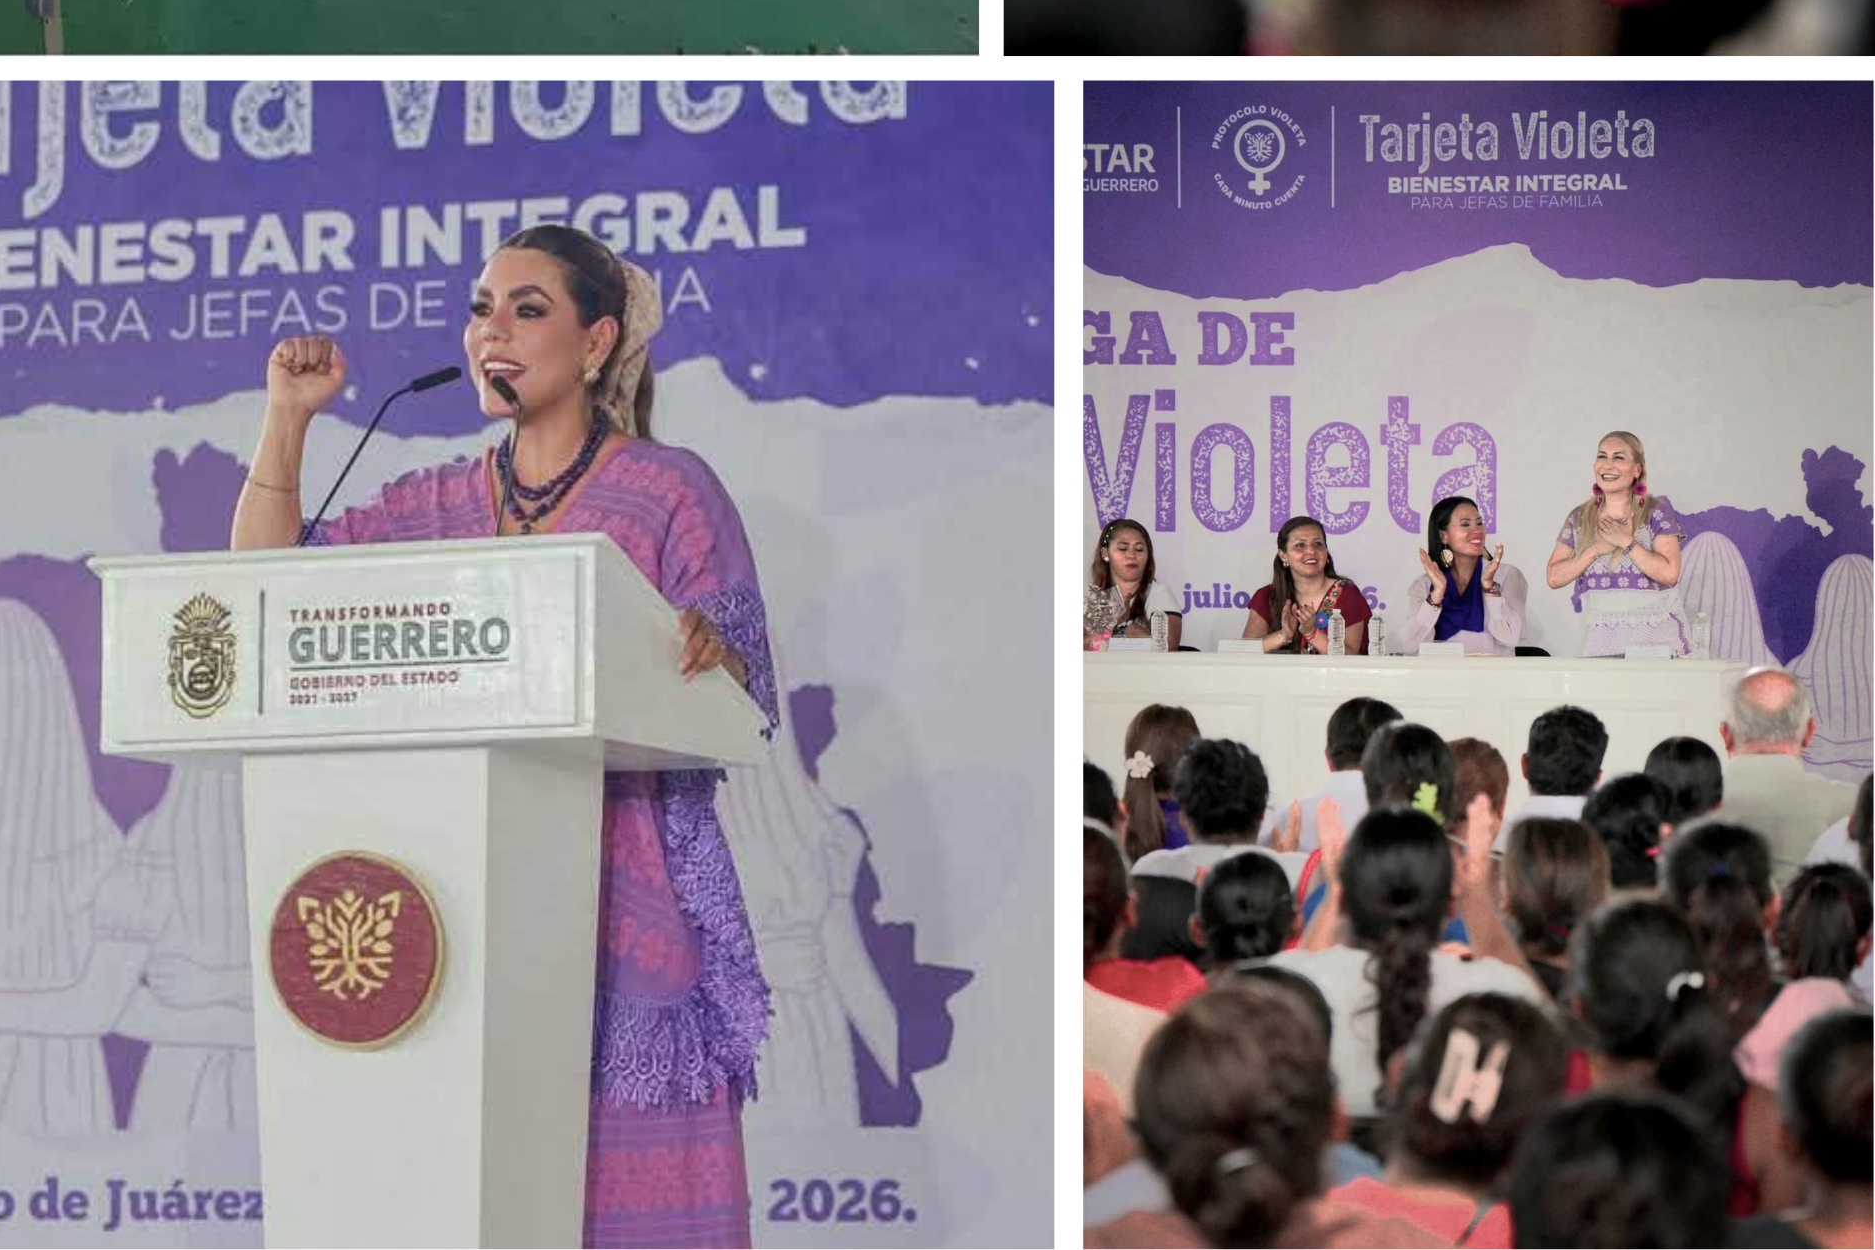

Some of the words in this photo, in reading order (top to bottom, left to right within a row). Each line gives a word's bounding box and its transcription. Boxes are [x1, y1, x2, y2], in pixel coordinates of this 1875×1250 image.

[1211, 105, 1267, 149] PROTOCOLO
[1270, 107, 1307, 147] VIOLETA
[1359, 112, 1499, 174] Tarjeta
[1511, 109, 1655, 160] Violeta
[1083, 143, 1156, 173] TAR
[1213, 173, 1233, 199] CADA
[1233, 195, 1272, 210] MINUTO
[1274, 173, 1306, 206] CUENTA
[1387, 175, 1510, 194] BIENESTAR
[1516, 173, 1628, 192] INTEGRAL
[1411, 196, 1455, 209] PARA
[1458, 195, 1508, 209] JEFAS
[1512, 195, 1535, 208] DE
[1539, 194, 1604, 208] FAMILIA
[169, 284, 349, 342] JEFAS
[369, 279, 446, 332] DE
[1197, 311, 1295, 366] DE
[1083, 389, 1498, 535] Violeta
[290, 602, 451, 624] TRANSFORMANDO
[1181, 583, 1251, 615] julio
[288, 617, 511, 664] GUERRERO
[289, 673, 366, 691] GOBIERNO
[369, 672, 399, 687] DEL
[401, 669, 459, 686] ESTADO
[289, 693, 318, 706] 2021
[329, 691, 359, 704] 2027
[28, 1176, 91, 1221] de
[102, 1178, 264, 1232] Juárez
[767, 1178, 917, 1223] 2026.
